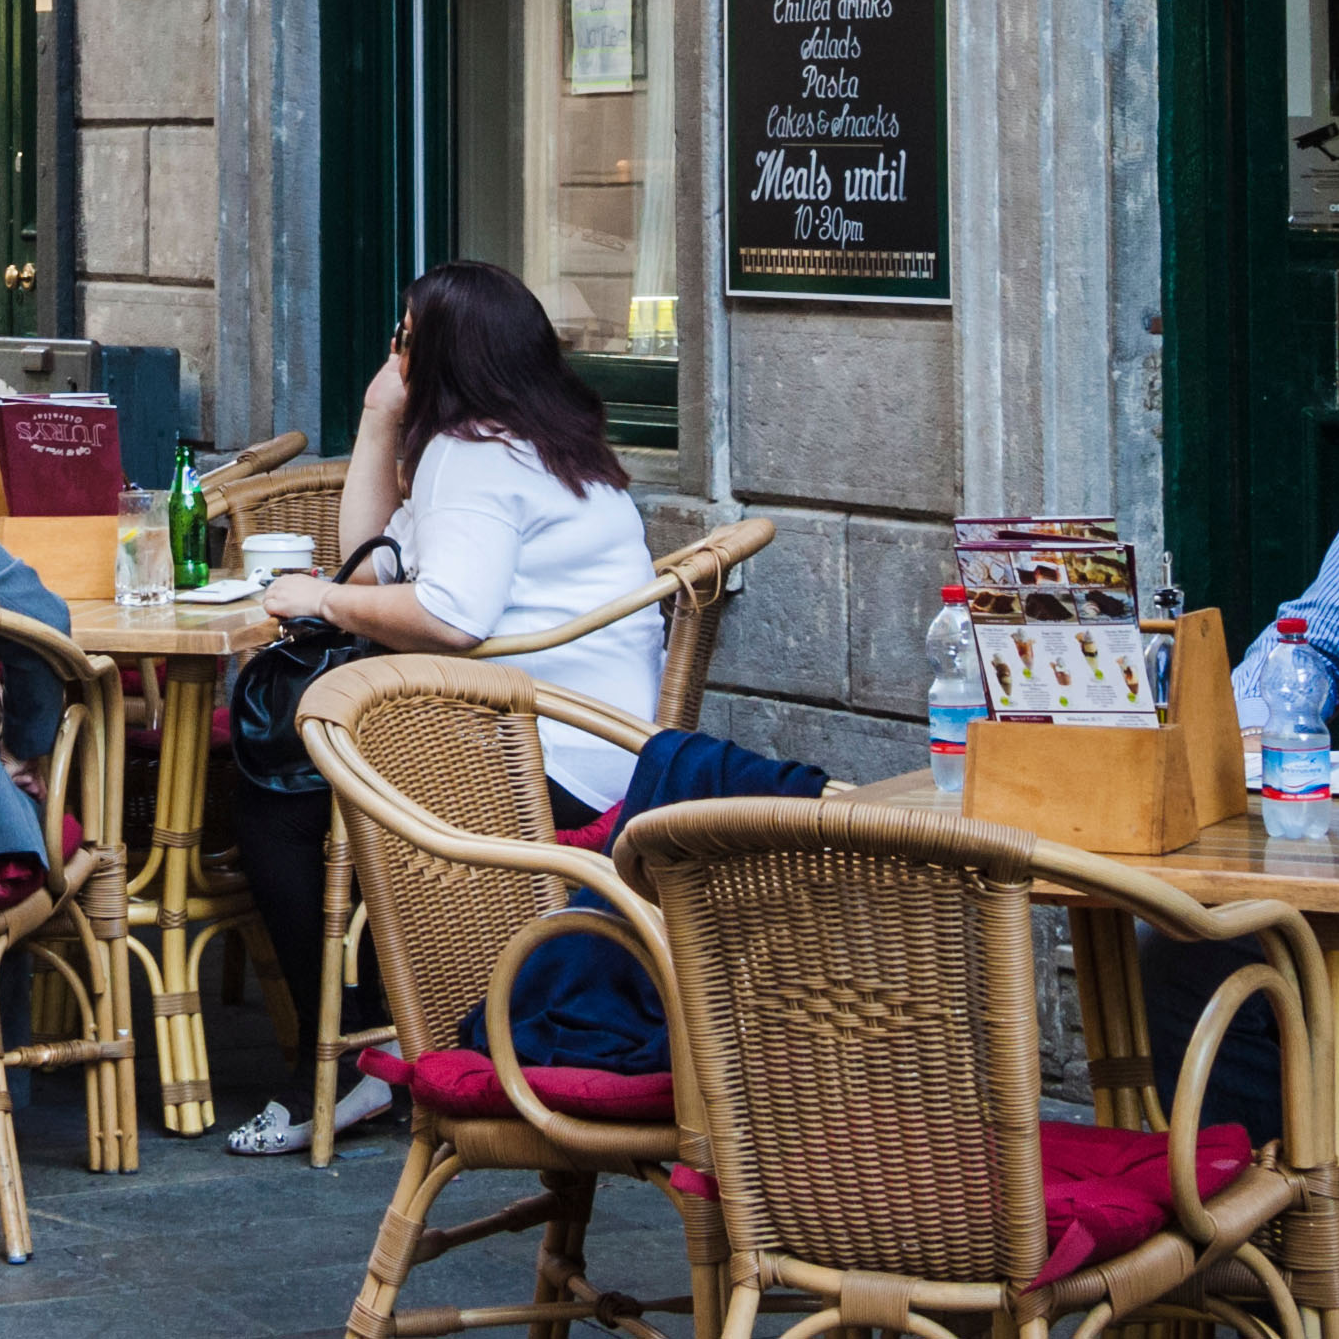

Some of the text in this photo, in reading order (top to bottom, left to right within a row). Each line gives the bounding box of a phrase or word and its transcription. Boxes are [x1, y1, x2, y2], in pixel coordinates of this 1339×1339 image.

[801, 25, 862, 61] Salads
[802, 65, 860, 99] Pasta
[751, 149, 907, 203] Meals until
[15, 421, 107, 447] JURY'S
